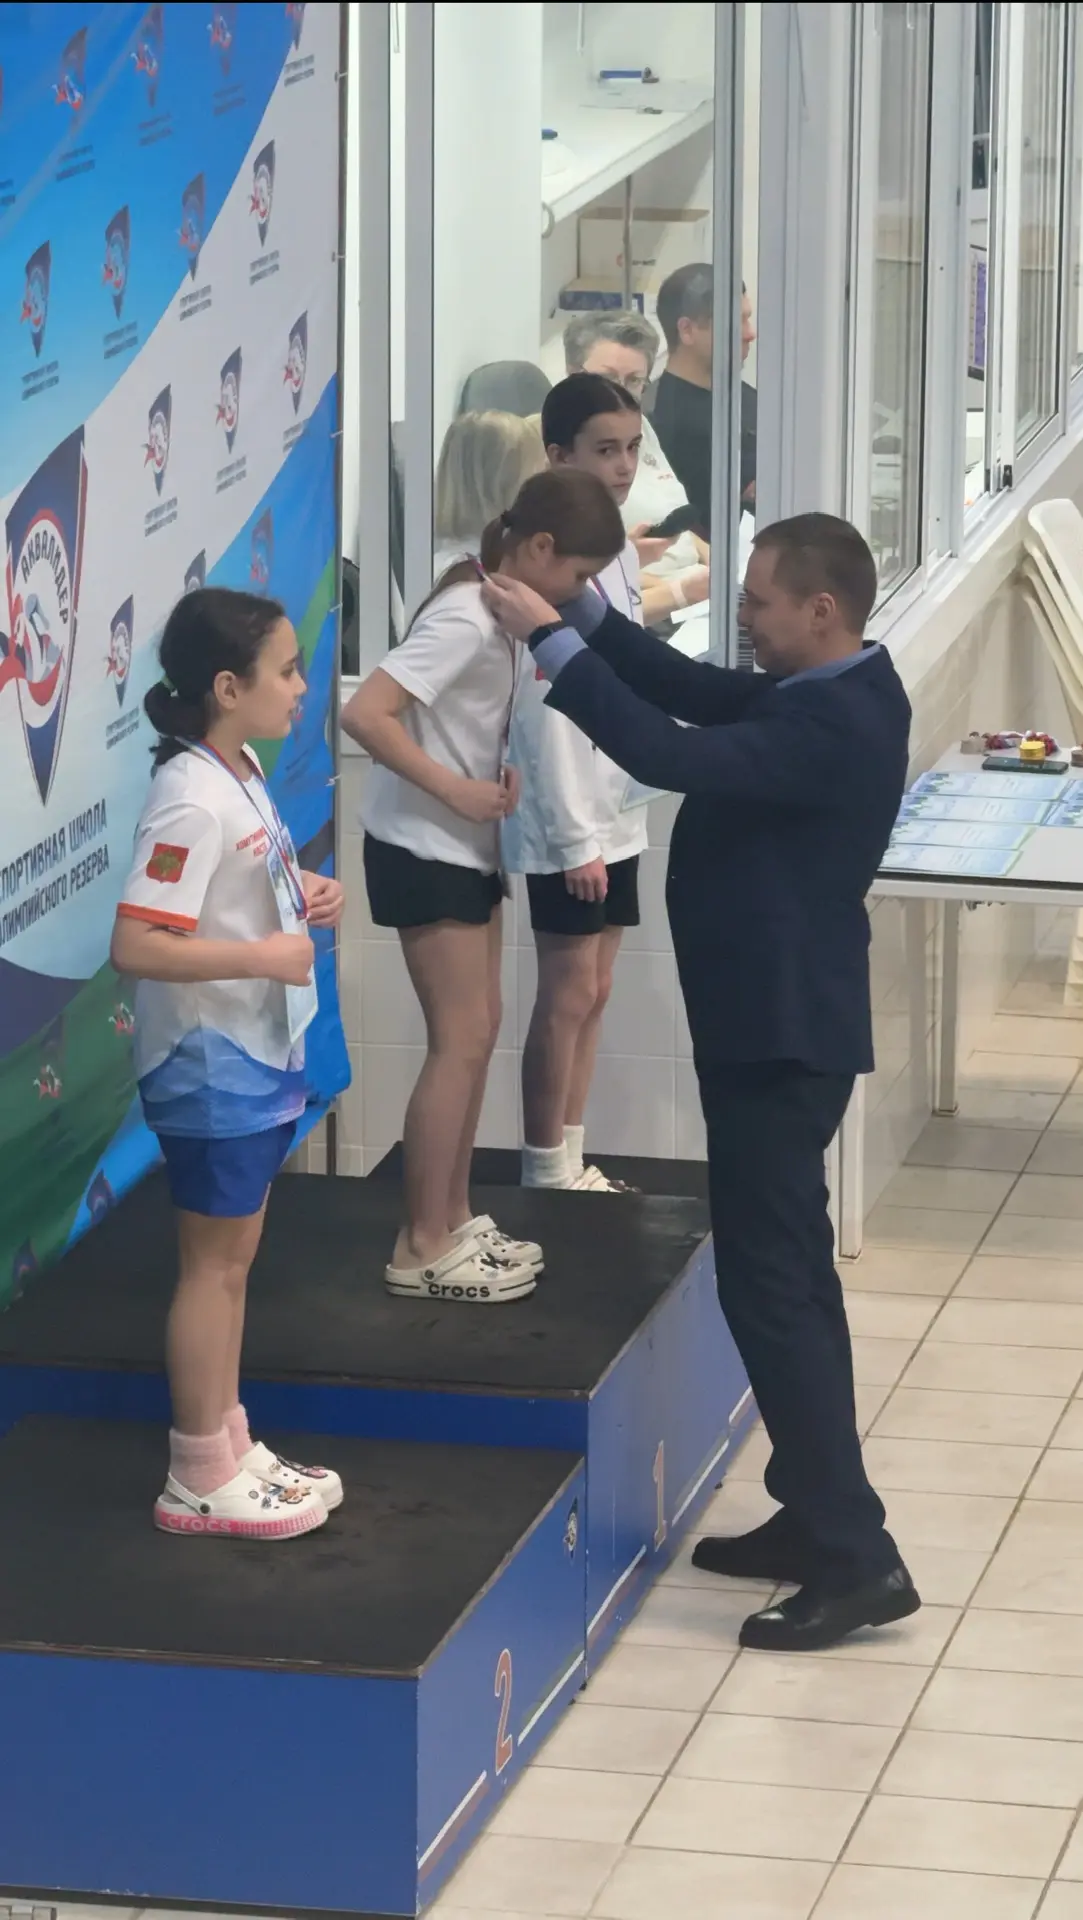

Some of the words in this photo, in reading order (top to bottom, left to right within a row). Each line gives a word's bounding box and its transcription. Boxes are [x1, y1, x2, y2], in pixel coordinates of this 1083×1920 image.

[21, 529, 69, 624] АКВАЛИДЕР
[69, 798, 108, 852] ШКОЛА
[0, 873, 67, 947] ЛИМПИЙСКОГО
[70, 844, 110, 896] РЕЗЕРВА
[428, 1283, 491, 1298] crocs
[167, 1514, 233, 1533] crocs
[652, 1439, 667, 1553] 1
[494, 1647, 513, 1777] 2
